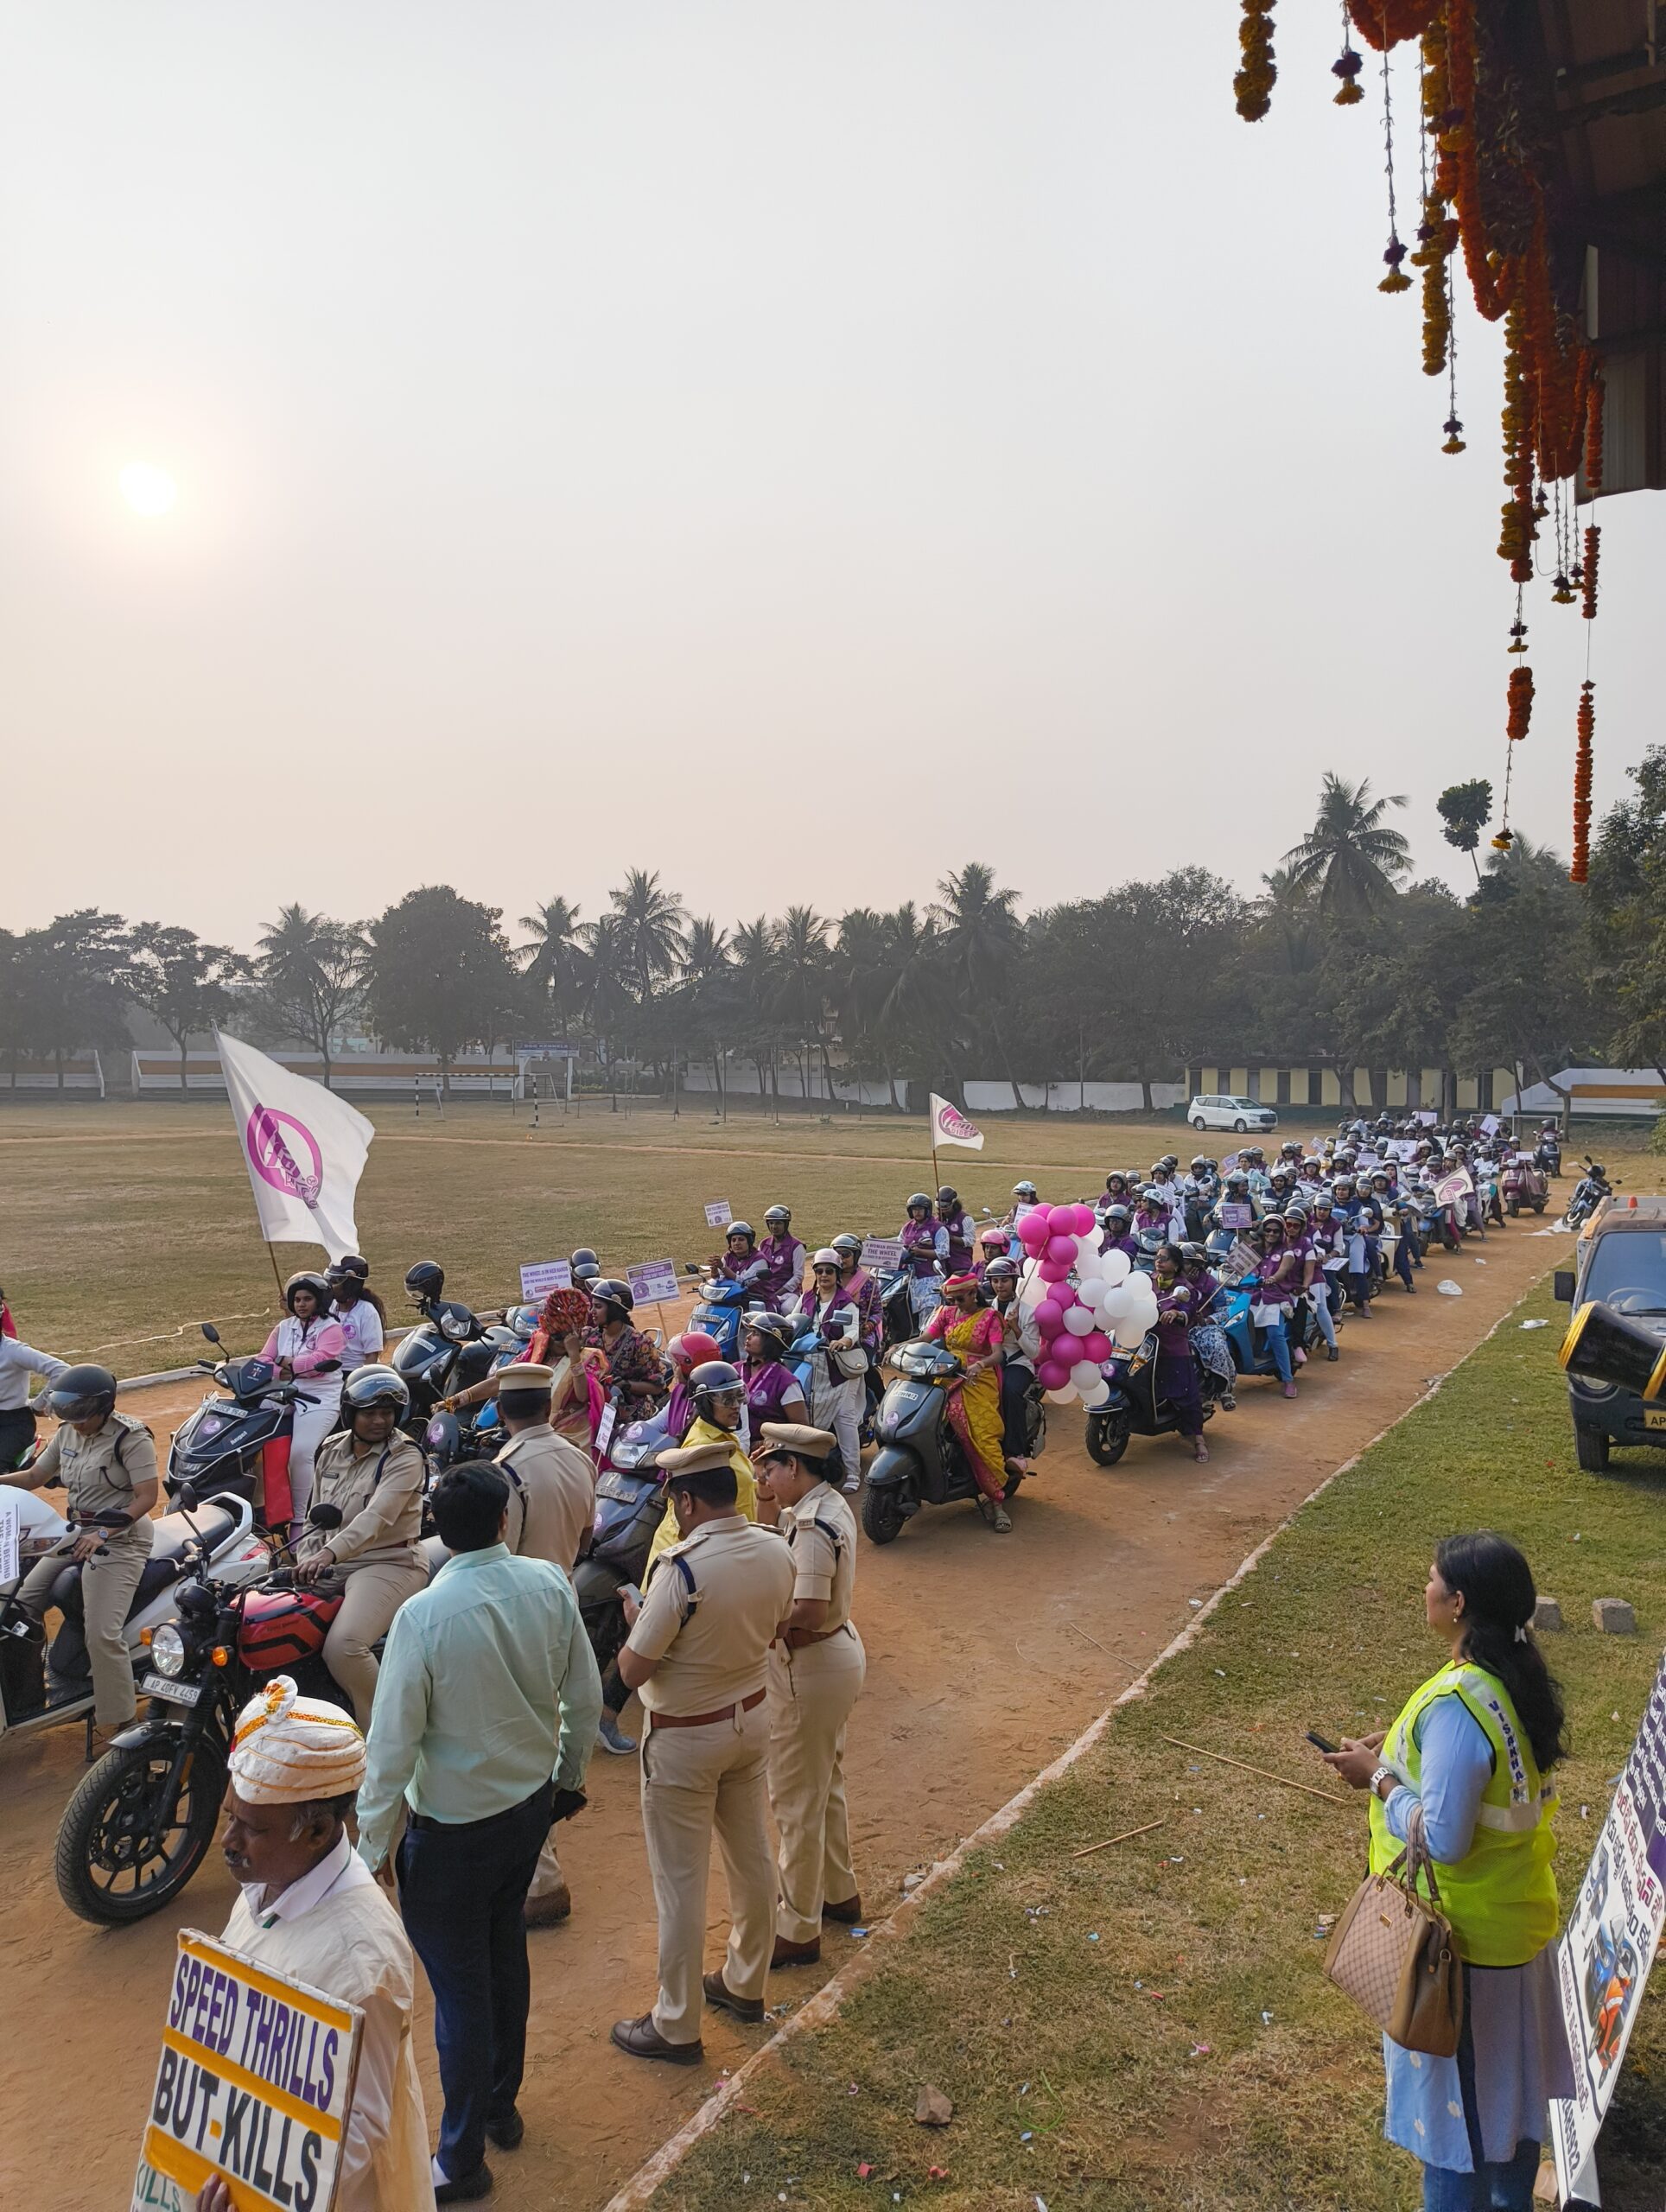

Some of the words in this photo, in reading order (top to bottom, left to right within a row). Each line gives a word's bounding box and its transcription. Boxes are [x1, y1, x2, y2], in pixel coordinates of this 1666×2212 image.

[1650, 1416, 1666, 1426] AP
[150, 1679, 161, 1689] AP
[170, 1954, 238, 2056] SPEED
[239, 1988, 338, 2113] THRILLS
